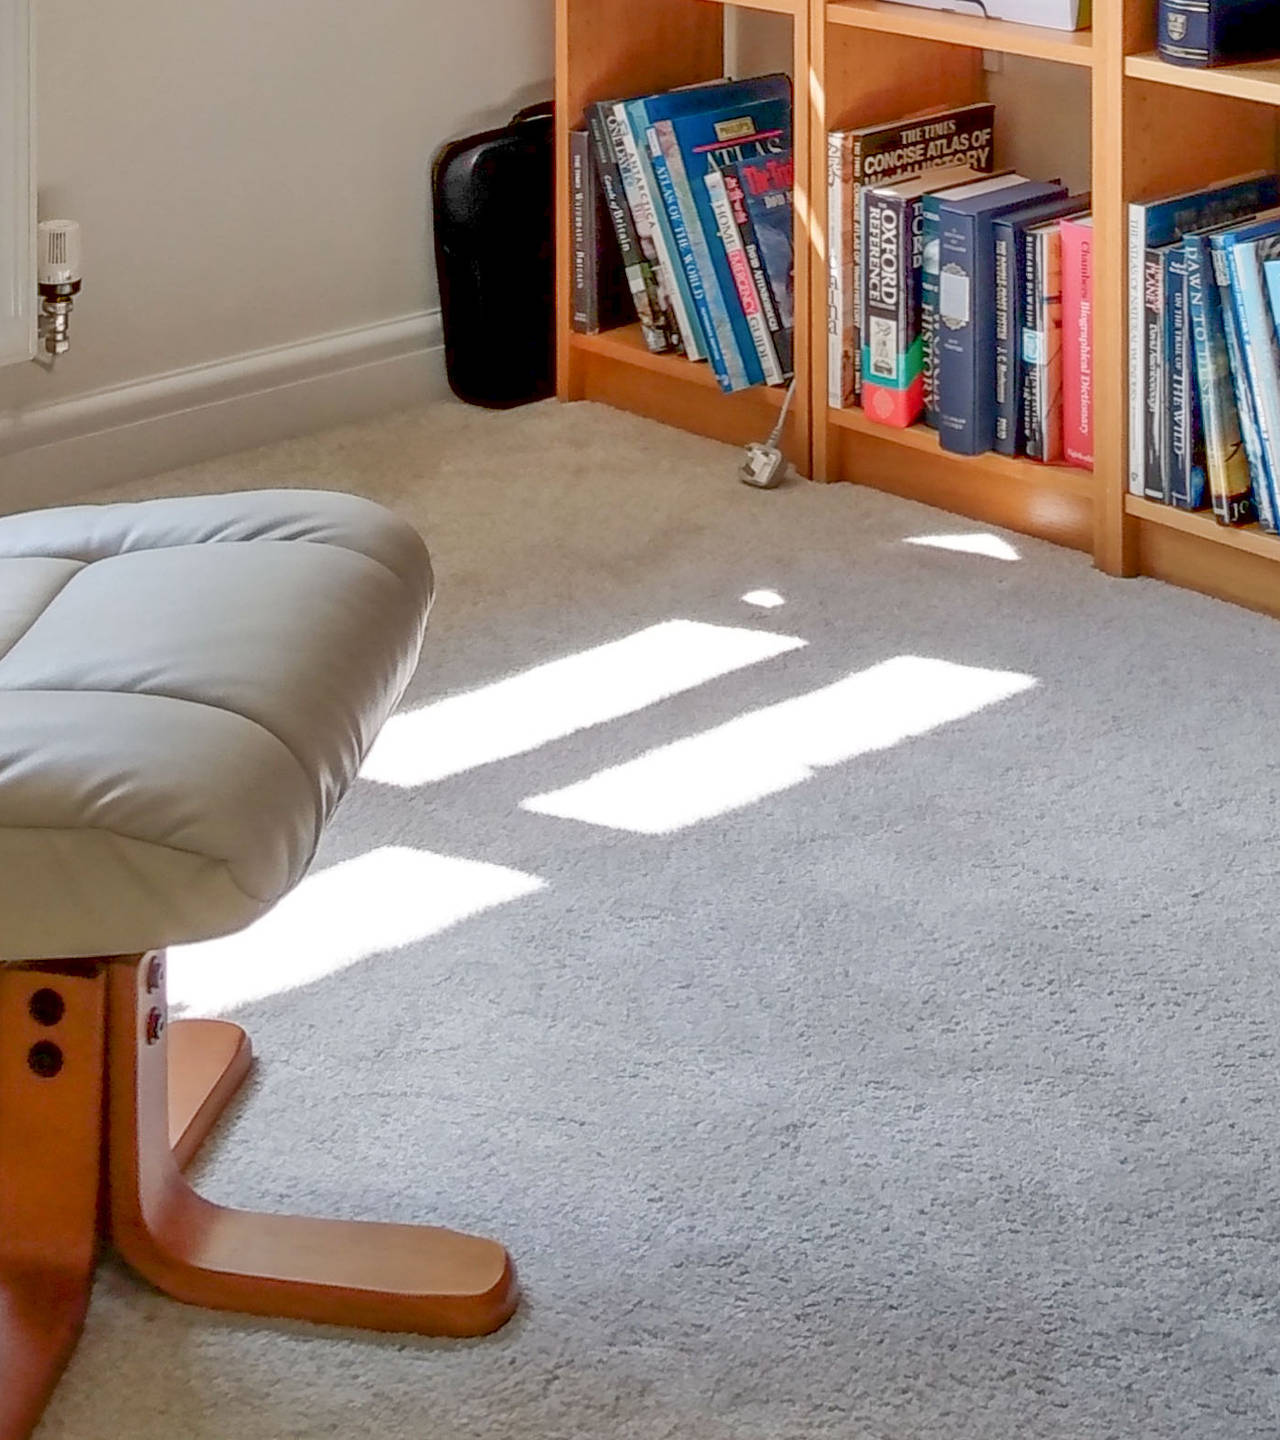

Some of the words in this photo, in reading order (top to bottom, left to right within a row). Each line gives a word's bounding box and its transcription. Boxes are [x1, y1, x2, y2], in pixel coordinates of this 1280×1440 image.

[864, 145, 925, 174] CONCISE
[926, 135, 970, 159] ATLAS
[972, 129, 992, 147] OF
[900, 130, 925, 144] THE
[925, 120, 957, 139] TIMES
[629, 153, 655, 228] ANTARCTICA
[655, 165, 673, 203] ATLAS
[613, 210, 631, 252] Britain
[669, 205, 680, 221] OF
[672, 226, 687, 248] THE
[869, 207, 881, 300] REFERENCE
[880, 209, 899, 302] OXFORD
[1025, 236, 1035, 280] RICHARD
[684, 254, 703, 300] WORLD
[715, 201, 734, 246] HOME
[748, 317, 770, 361] GUIDE
[1080, 241, 1090, 301] Chambers
[1184, 247, 1202, 305] DAWN
[1194, 317, 1207, 341] TO
[1078, 302, 1091, 374] Biographical
[1078, 375, 1091, 436] Dictionary
[1173, 374, 1184, 408] THE
[1173, 411, 1184, 453] WILD
